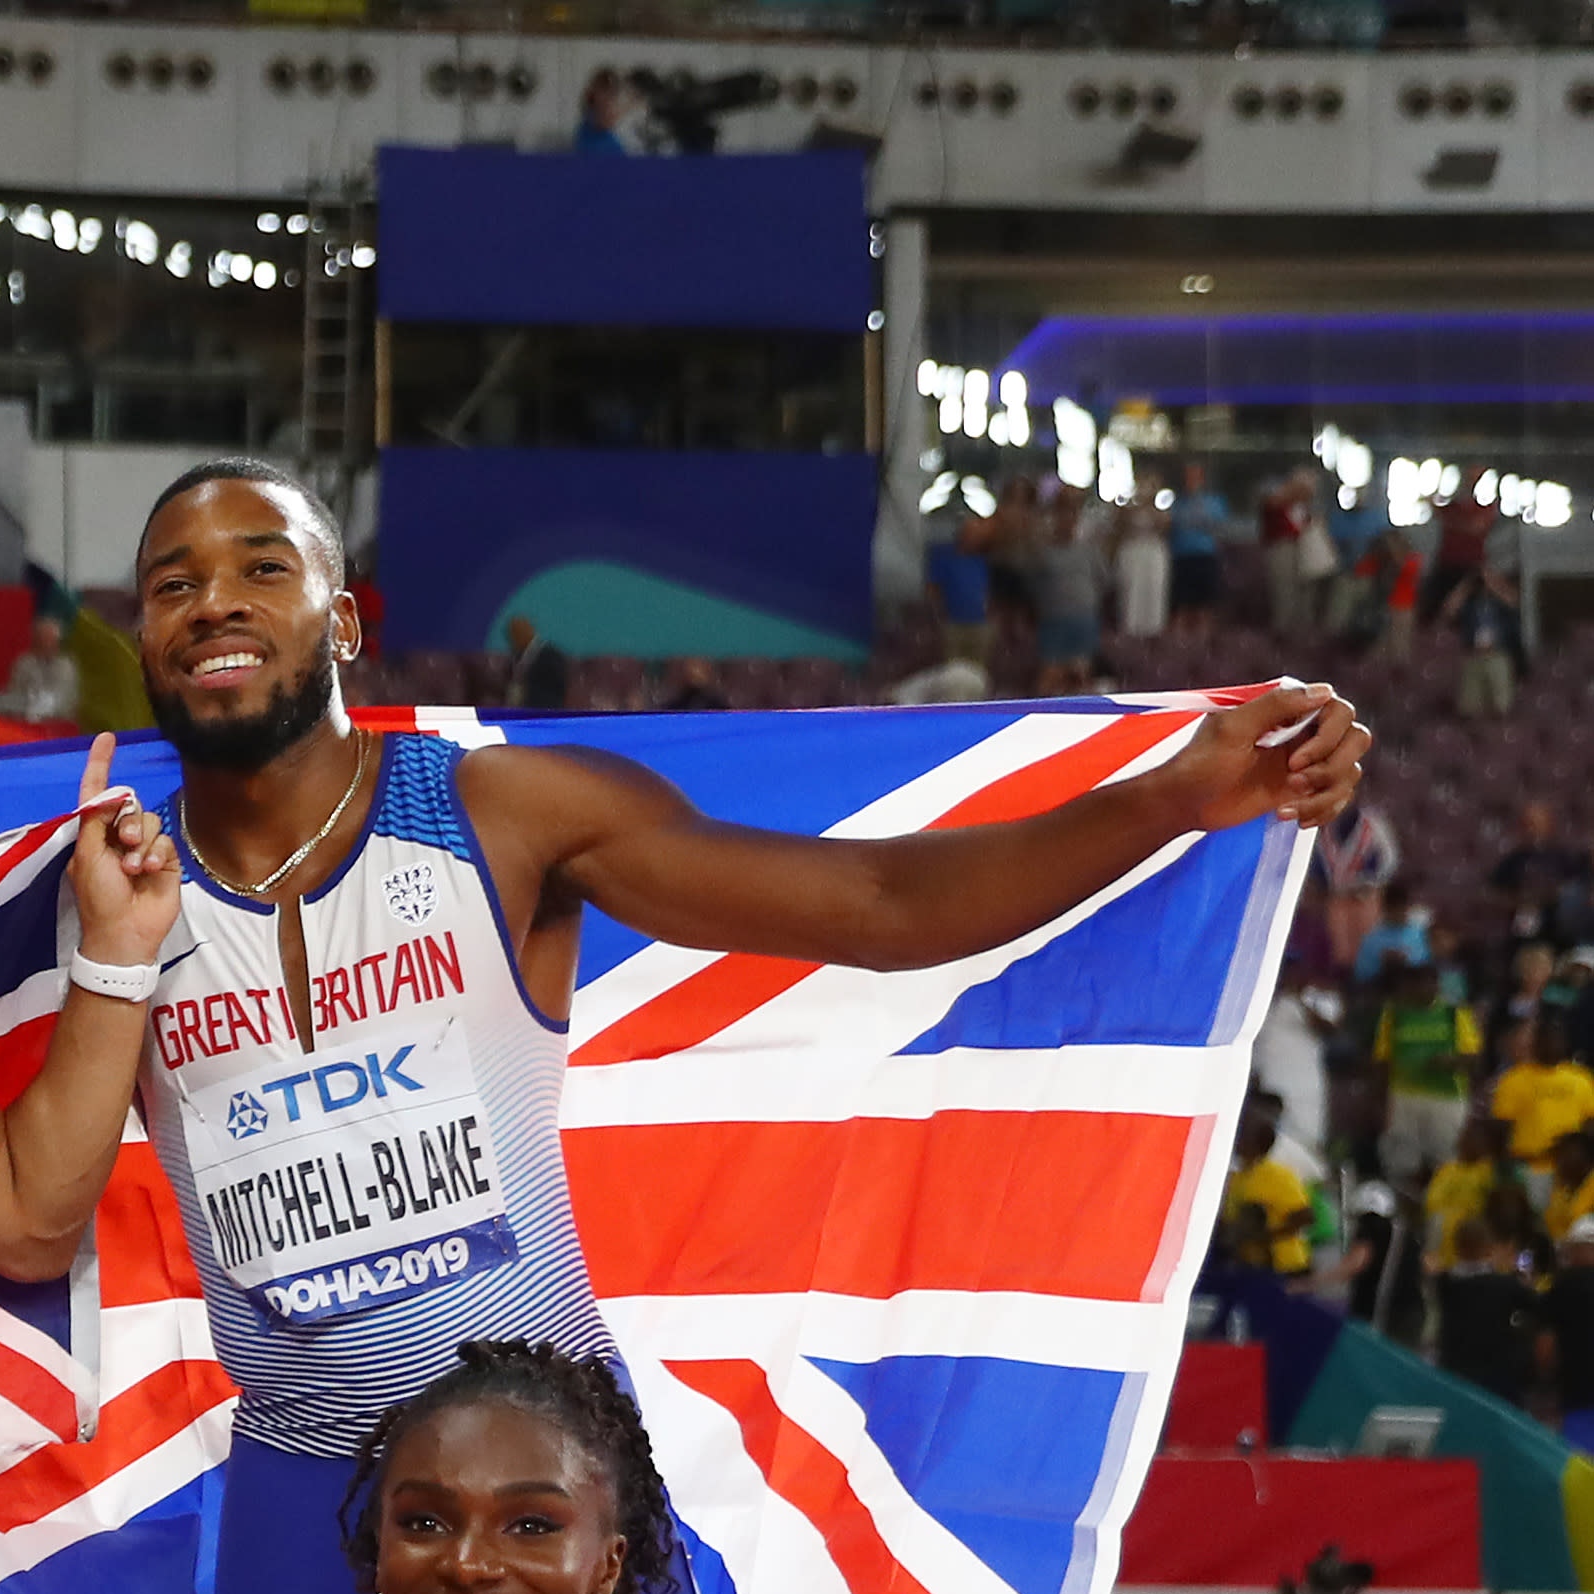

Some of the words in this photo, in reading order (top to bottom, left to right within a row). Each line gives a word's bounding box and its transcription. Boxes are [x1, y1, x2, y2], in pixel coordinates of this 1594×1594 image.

[151, 987, 272, 1071] GREAT
[277, 931, 465, 1040] BRITAIN
[262, 1044, 425, 1123] TDK
[206, 1115, 490, 1271] MITCHELL-BLAKE
[264, 1236, 470, 1319] DOHA2019
